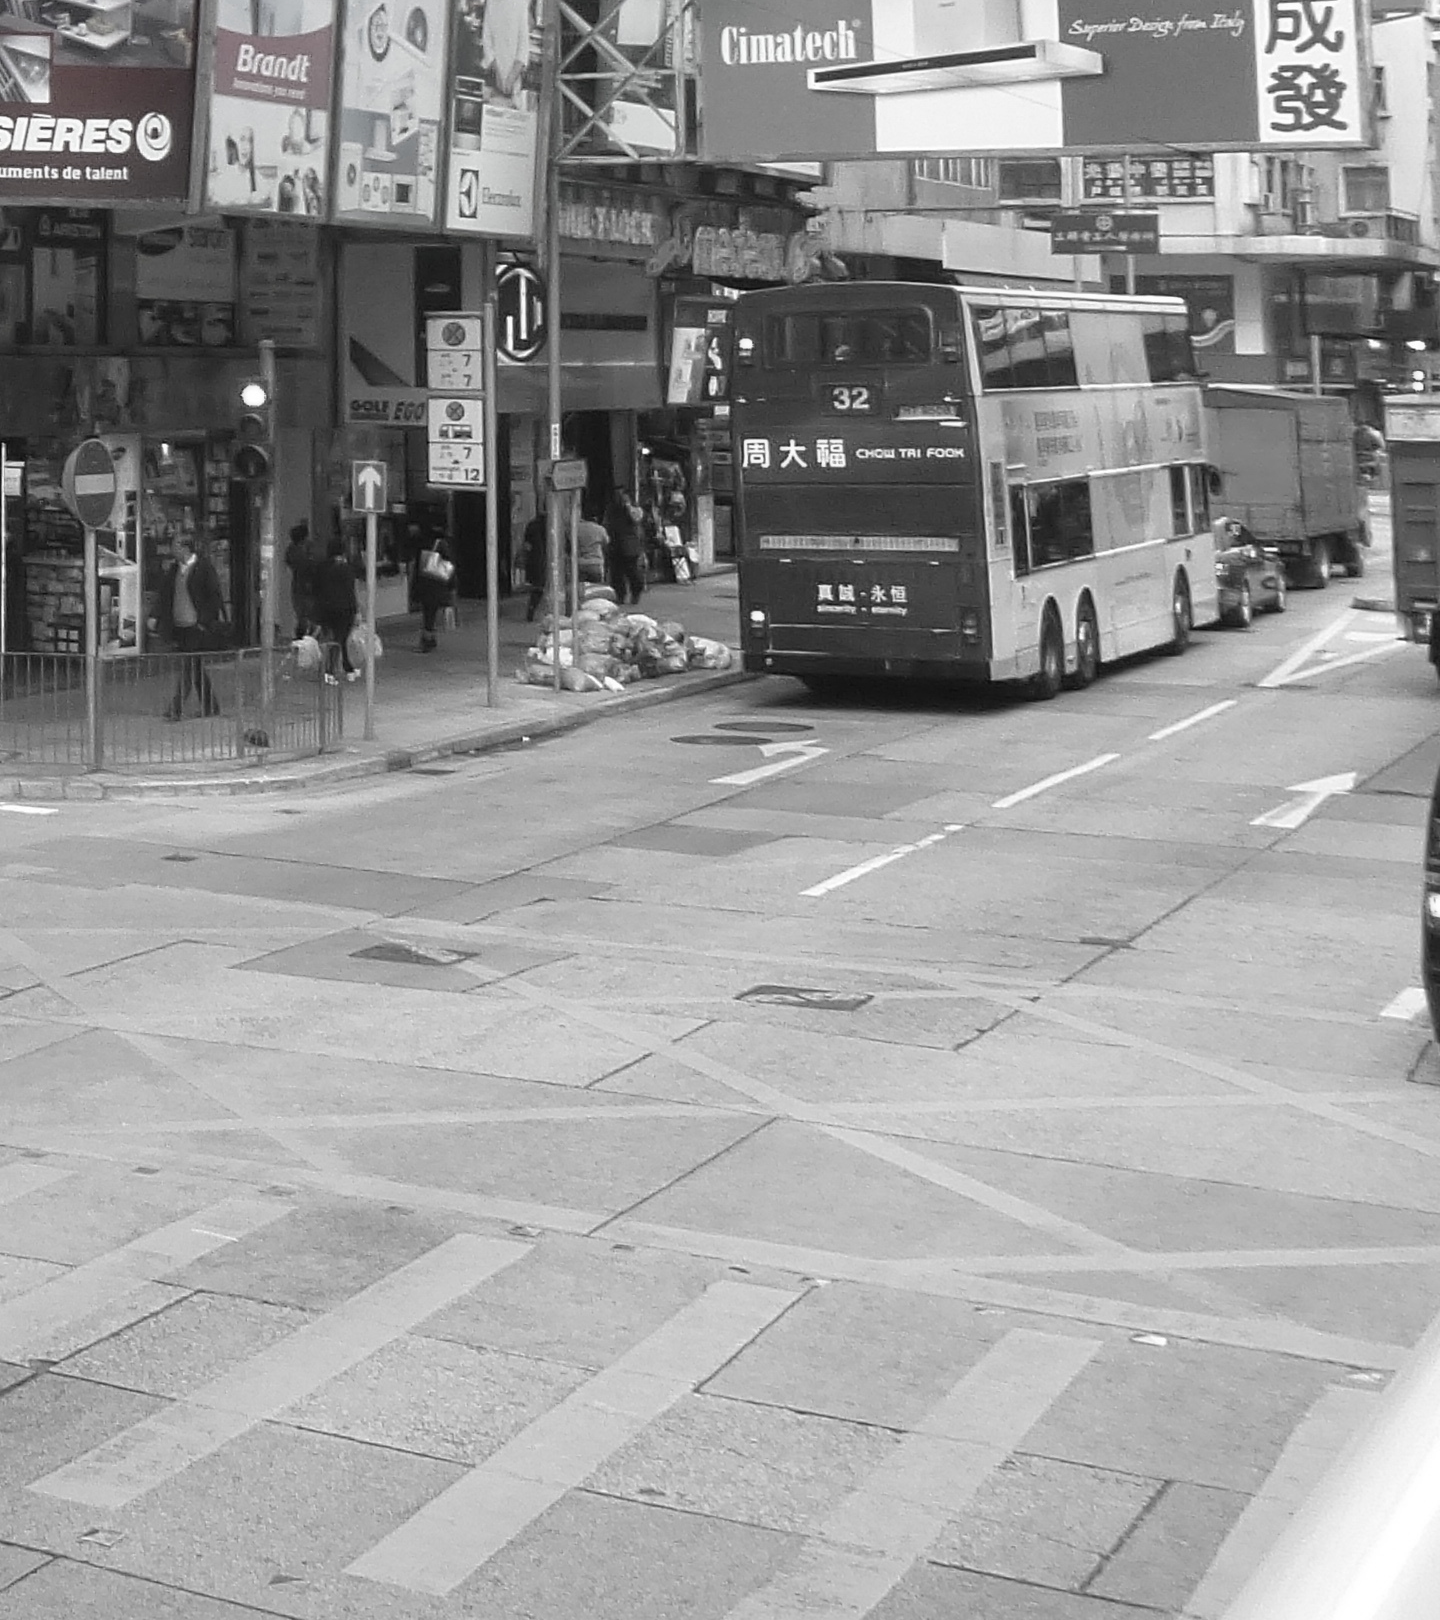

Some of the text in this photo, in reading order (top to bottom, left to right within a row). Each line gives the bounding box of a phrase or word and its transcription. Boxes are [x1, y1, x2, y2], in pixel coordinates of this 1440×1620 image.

[720, 20, 857, 66] Cimatech
[236, 43, 312, 84] Brandt
[62, 164, 82, 180] de
[85, 165, 129, 181] talent
[462, 354, 472, 367] 7
[463, 374, 473, 387] 7
[832, 386, 870, 410] 32
[463, 446, 473, 460] 7
[742, 438, 847, 468] 周大福
[855, 447, 965, 460] CHOW TAI FOOK
[464, 469, 480, 482] 12
